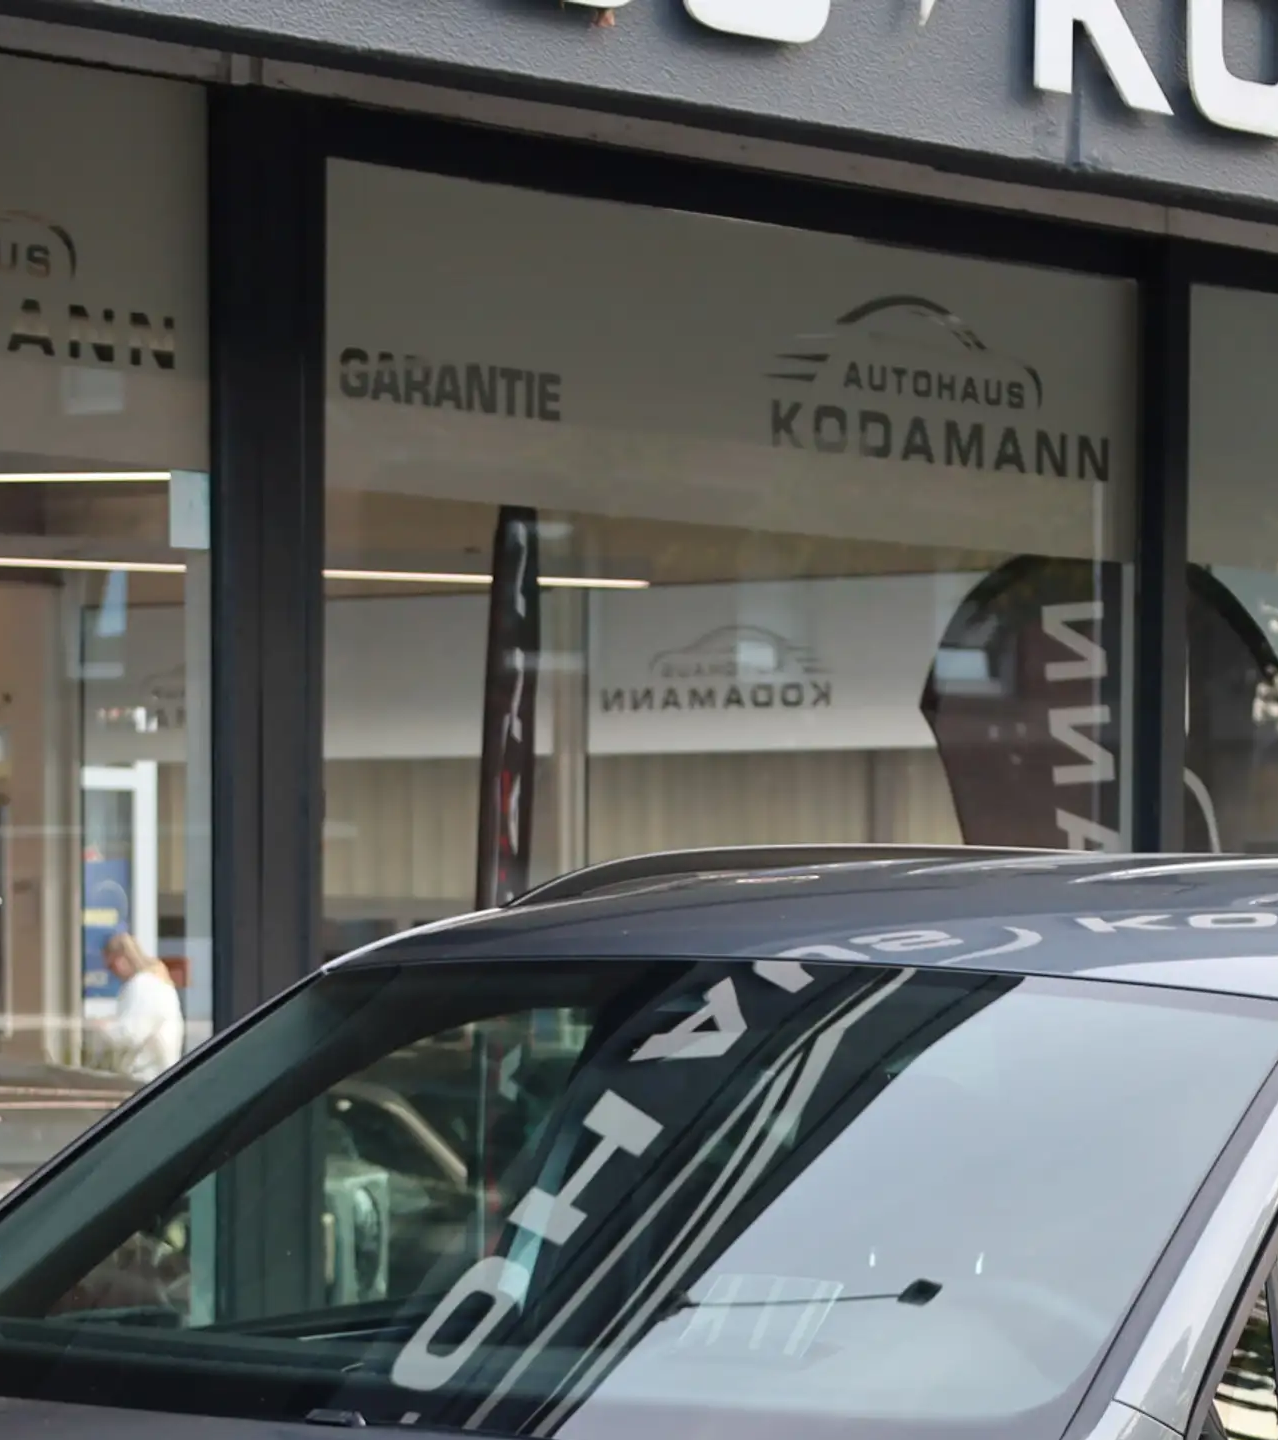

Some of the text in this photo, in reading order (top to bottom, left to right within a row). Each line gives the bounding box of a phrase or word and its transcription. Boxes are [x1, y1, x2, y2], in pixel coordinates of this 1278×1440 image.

[339, 346, 561, 422] GARANTIE
[843, 360, 1025, 409] AUTOHAUS
[770, 399, 1111, 482] KODAMANN
